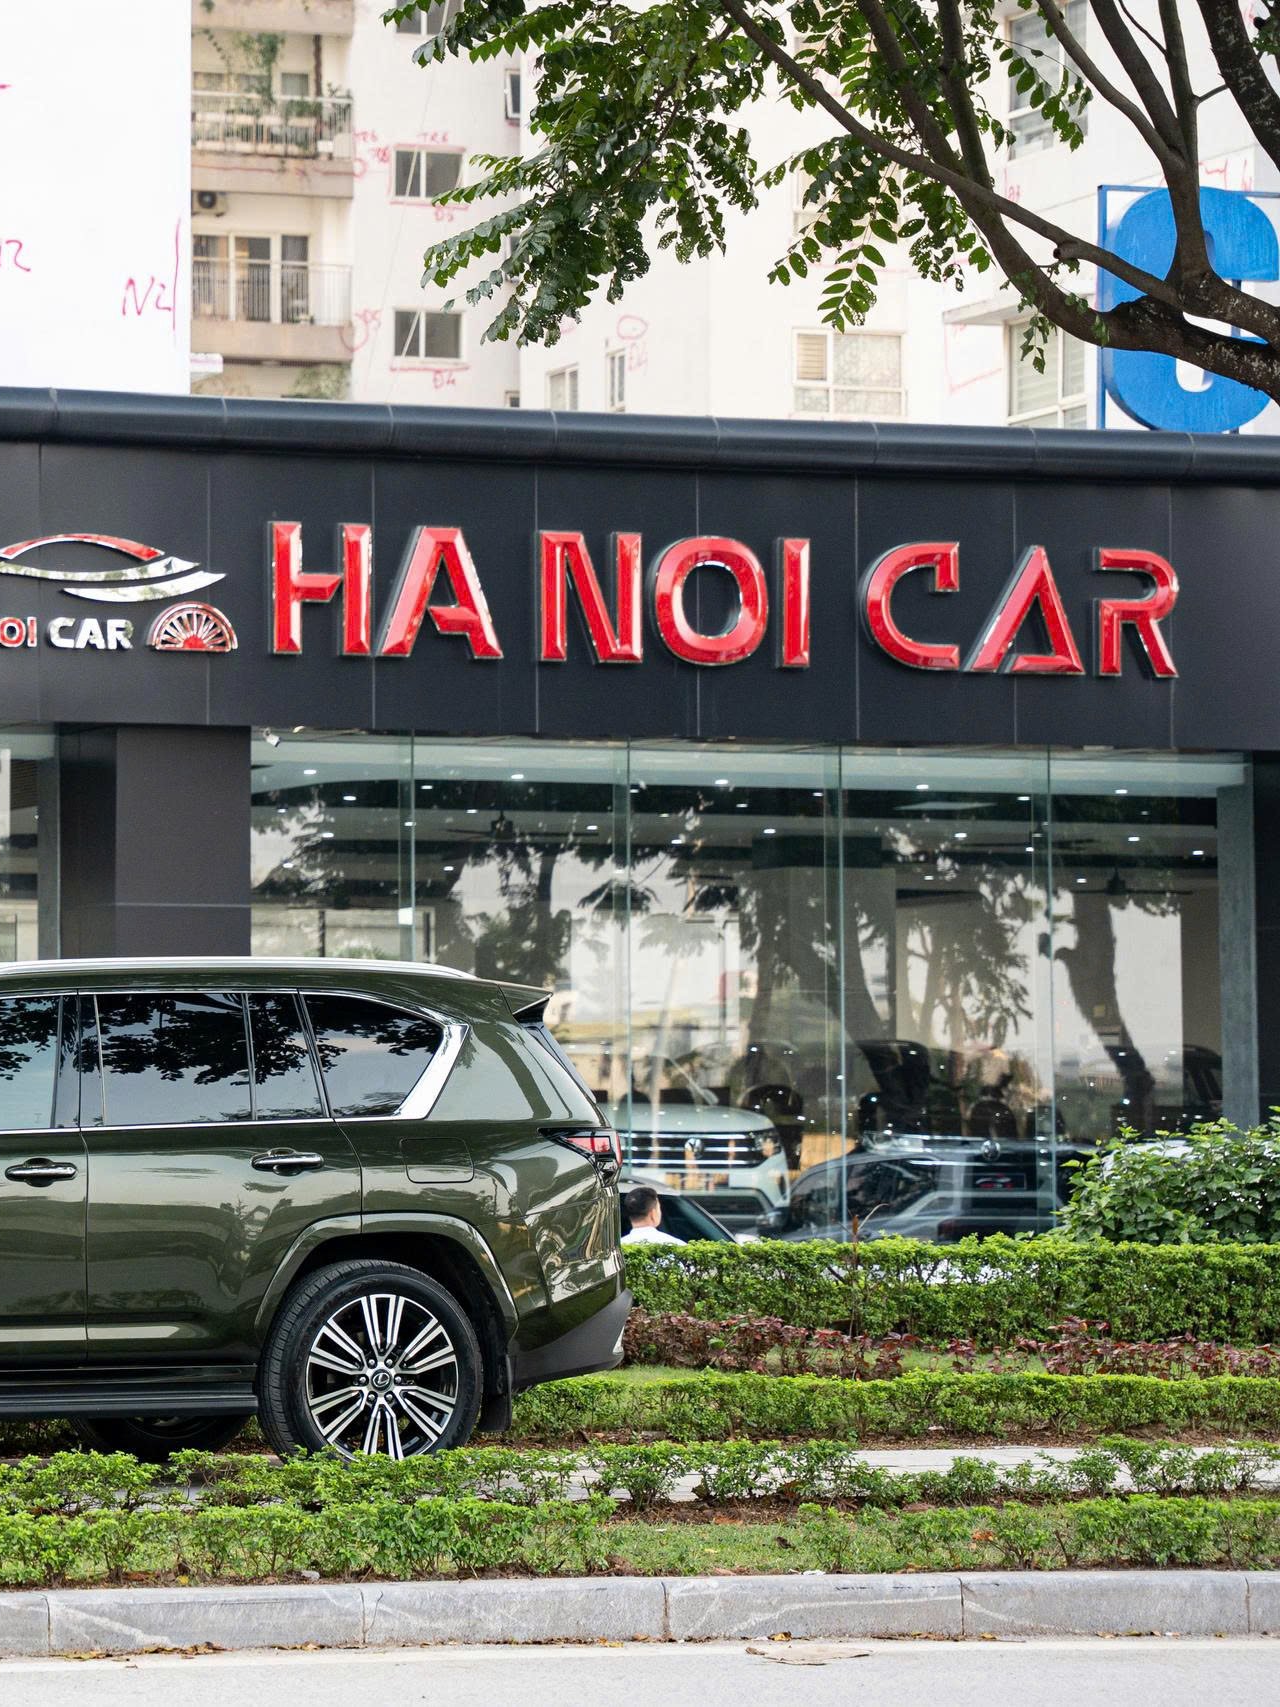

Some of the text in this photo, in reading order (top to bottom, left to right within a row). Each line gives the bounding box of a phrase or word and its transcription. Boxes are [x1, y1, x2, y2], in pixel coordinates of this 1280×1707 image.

[47, 616, 133, 651] CAR
[268, 520, 1180, 679] HA NOI CAR
